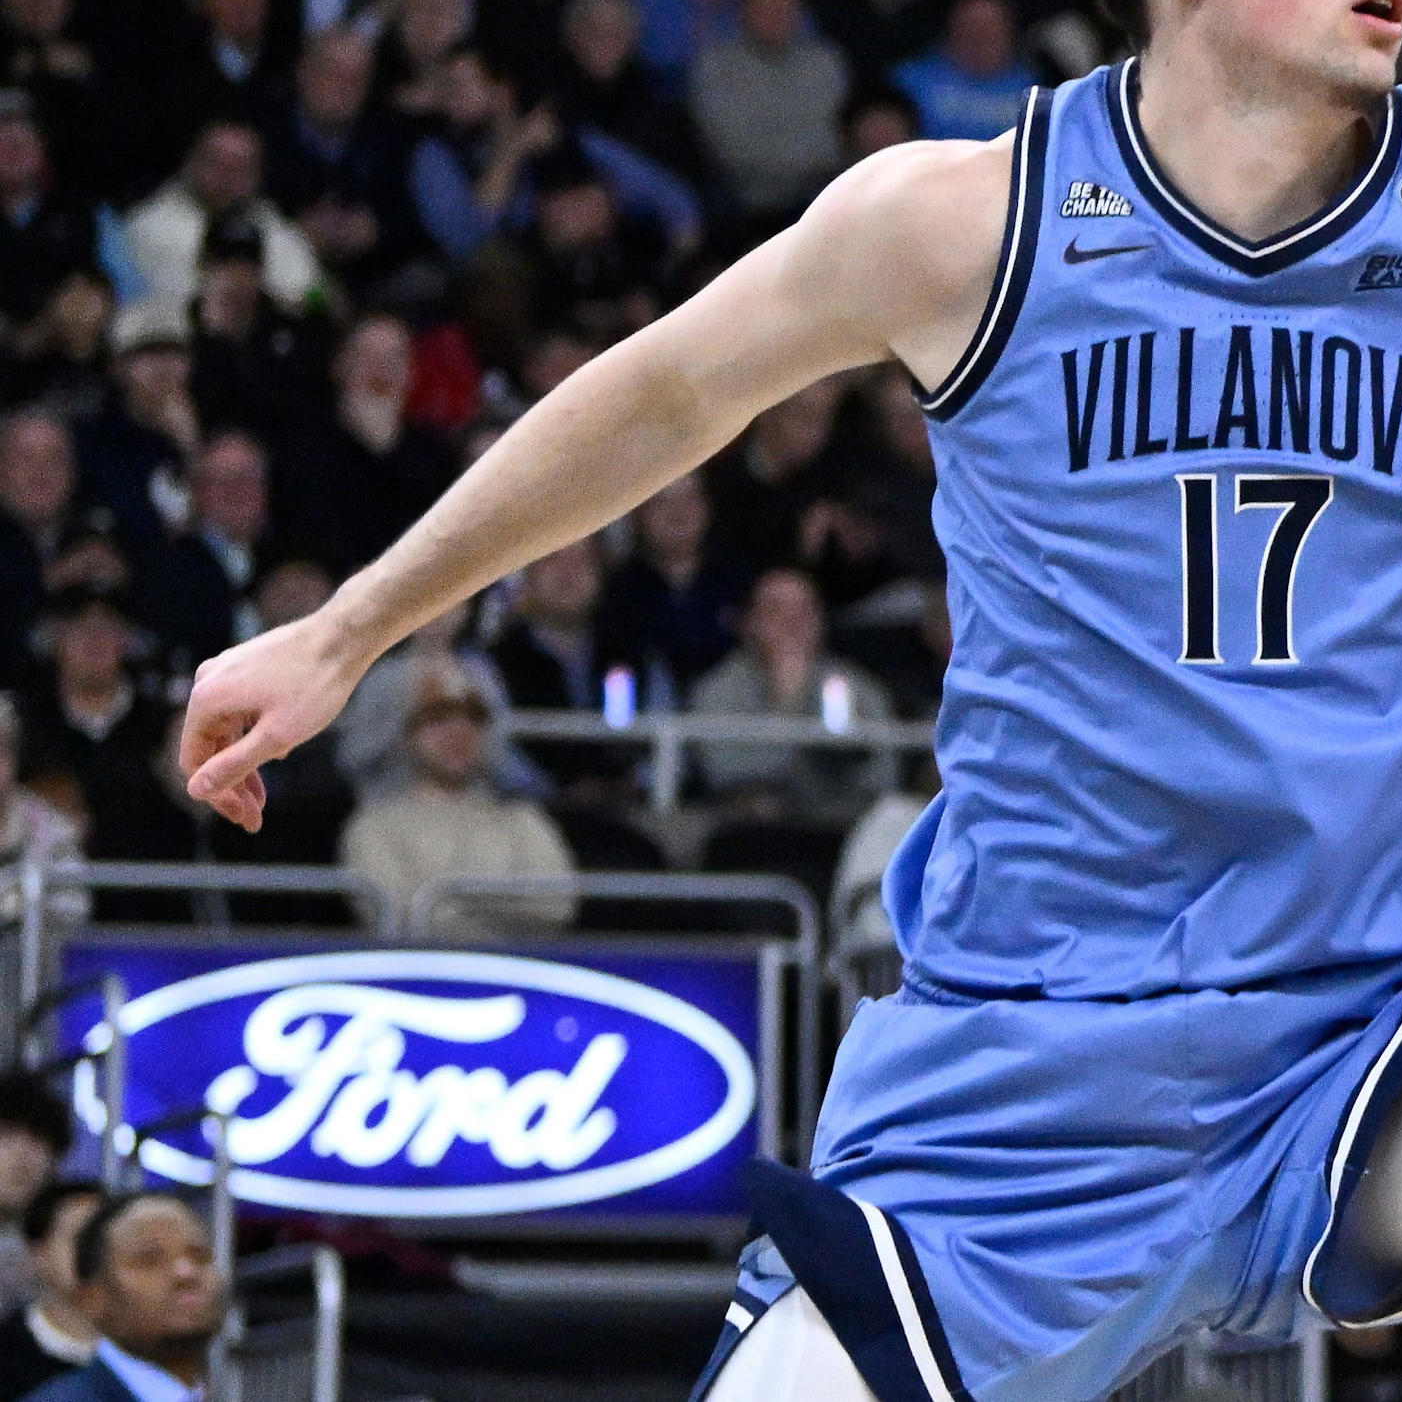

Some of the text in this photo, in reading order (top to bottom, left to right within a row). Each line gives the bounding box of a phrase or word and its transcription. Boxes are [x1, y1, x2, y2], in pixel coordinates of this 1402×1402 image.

[1060, 197, 1133, 217] CHANGE
[1069, 181, 1094, 199] BE
[1175, 473, 1335, 666] 17
[203, 982, 628, 1172] Ford
